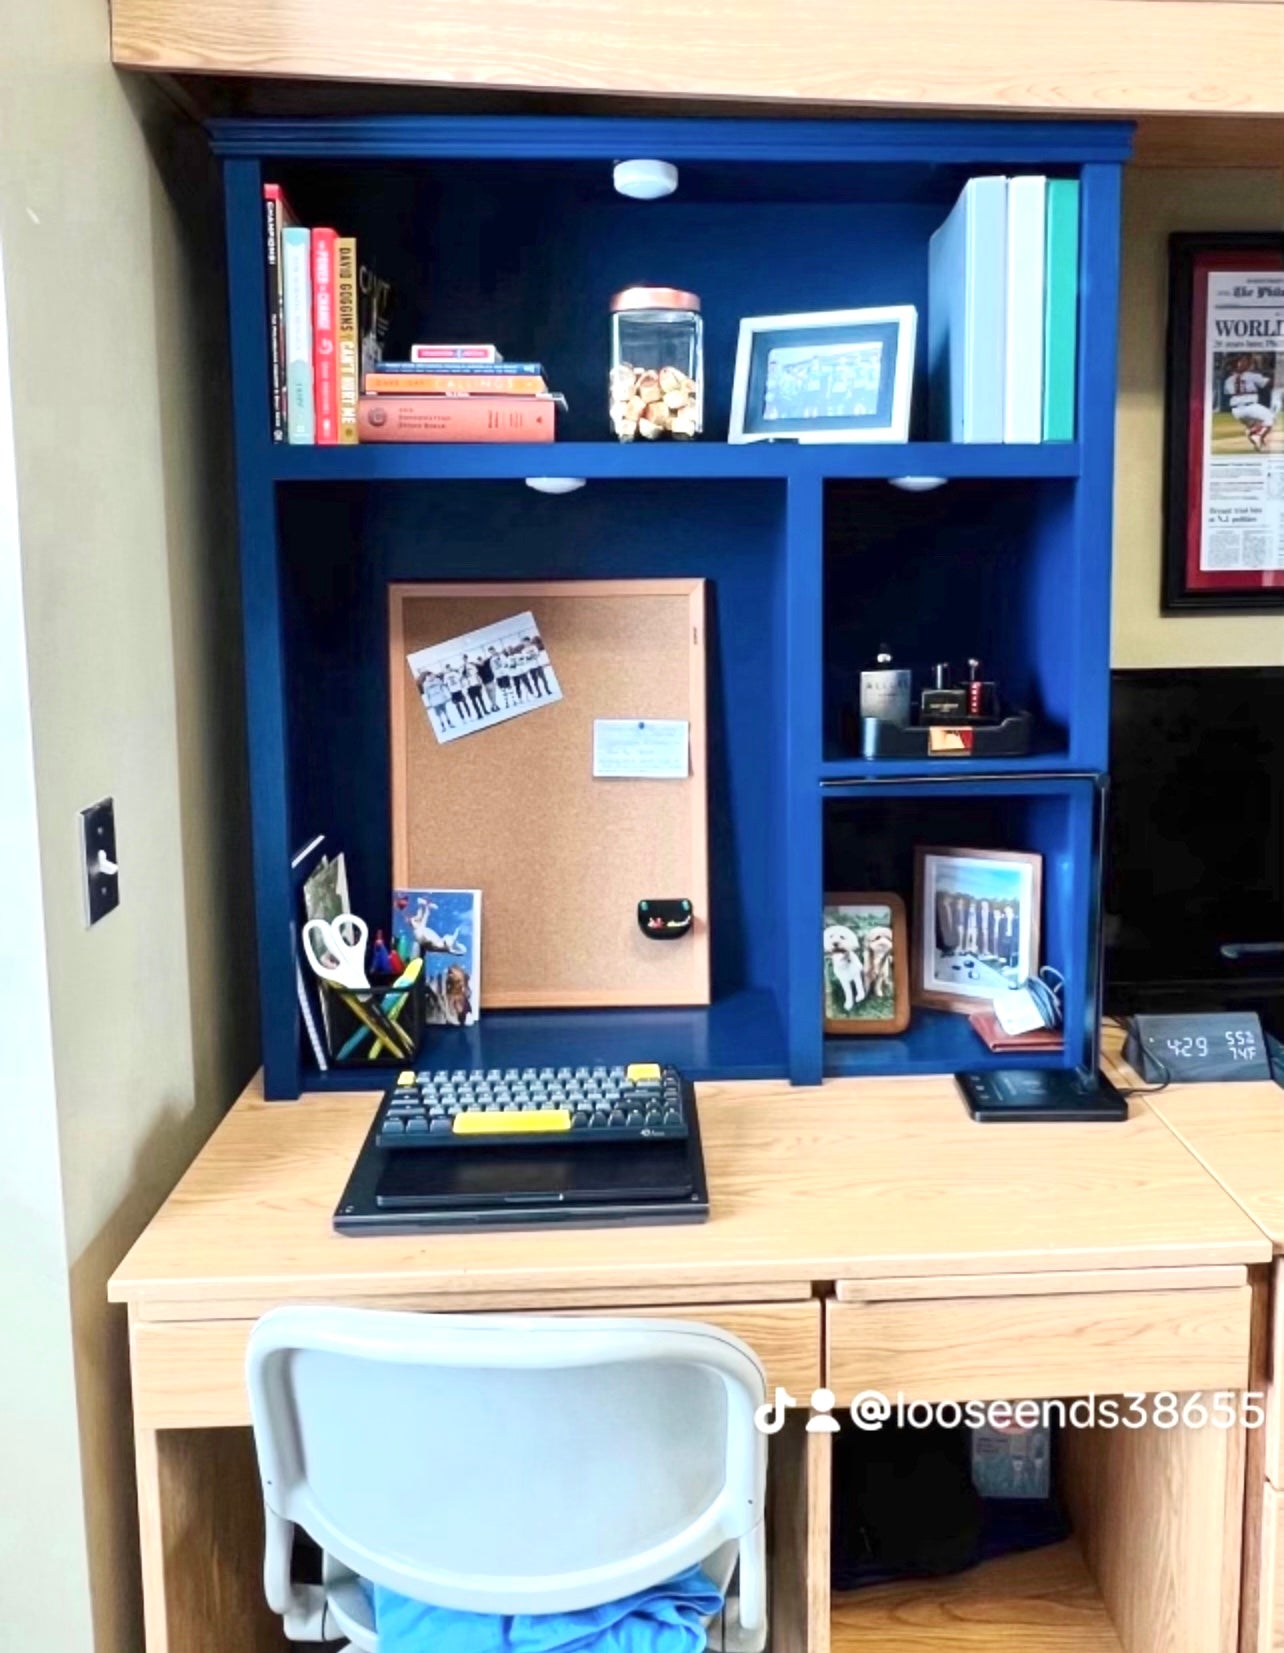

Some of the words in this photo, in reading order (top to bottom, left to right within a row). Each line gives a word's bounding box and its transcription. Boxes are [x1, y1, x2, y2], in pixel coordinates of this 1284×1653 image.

[340, 247, 352, 279] DAVID
[340, 283, 353, 331] GOGGINS
[341, 341, 355, 374] CAN'T
[341, 377, 355, 405] HURT
[342, 407, 355, 424] ME
